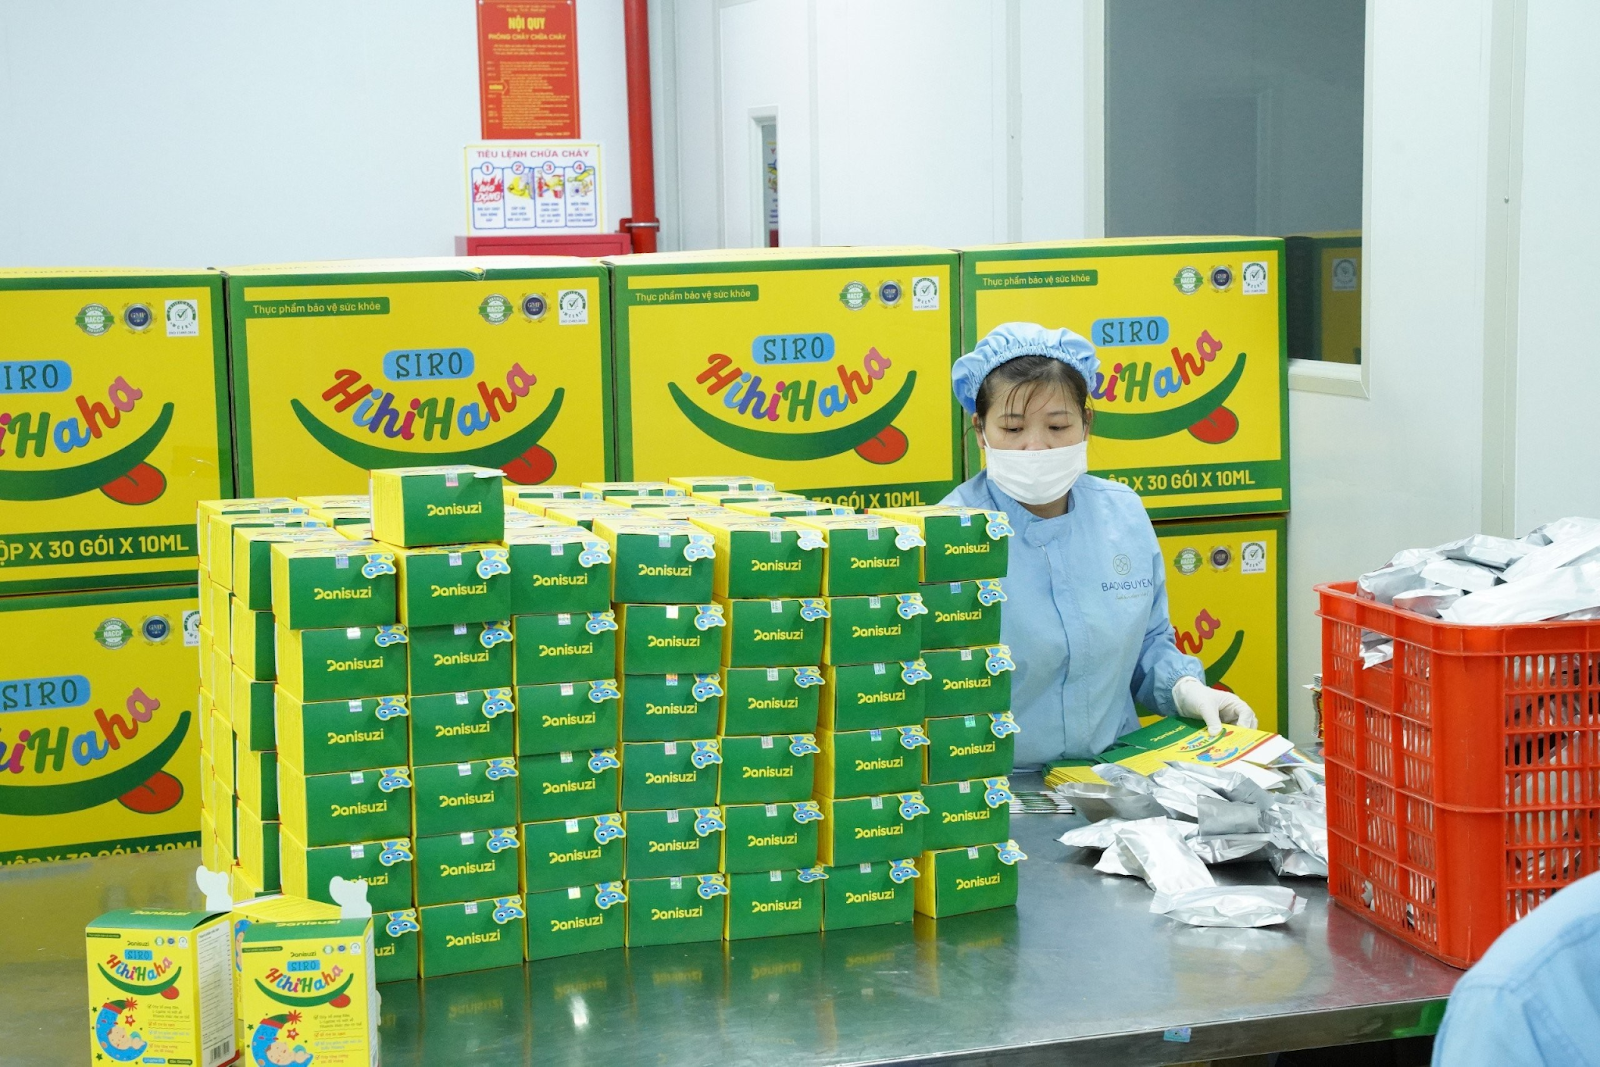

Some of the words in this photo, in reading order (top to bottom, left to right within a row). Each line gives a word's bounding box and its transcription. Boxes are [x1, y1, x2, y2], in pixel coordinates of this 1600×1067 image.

[508, 15, 525, 32] NỘI
[527, 17, 546, 31] QUY
[476, 149, 498, 158] TIÊU
[501, 149, 527, 160] LỆNH
[530, 149, 558, 158] CHỮA
[562, 149, 589, 158] CHÁY
[982, 277, 1003, 287] Thực
[1004, 275, 1027, 286] phẩm
[1028, 275, 1043, 284] bảo
[1044, 275, 1053, 285] vệ
[1055, 274, 1070, 283] sức
[1071, 273, 1090, 282] khỏe
[636, 293, 657, 303] Thực
[658, 290, 683, 302] phẩm
[684, 291, 700, 300] bảo
[702, 291, 712, 300] vệ
[713, 290, 729, 299] sức
[730, 289, 751, 298] khỏe
[253, 305, 277, 315] Thực
[279, 302, 305, 315] phẩm
[307, 303, 325, 313] bảo
[327, 303, 338, 313] vệ
[339, 302, 356, 312] sức
[358, 301, 381, 310] khỏe
[85, 315, 105, 324] HACCP
[1102, 319, 1159, 345] SIRO
[763, 336, 825, 363] SIRO
[395, 351, 463, 379] SIRO
[1091, 329, 1223, 402] iHaha
[4, 365, 59, 390] IRO
[695, 346, 892, 423] HihiHaha
[322, 362, 537, 441] HihiHaha
[0, 375, 143, 458] iHaha
[1133, 475, 1144, 491] X
[1147, 474, 1168, 490] 30
[1171, 469, 1198, 489] GÓI
[1201, 472, 1213, 487] X
[1216, 469, 1256, 486] 10ML
[869, 493, 881, 509] X
[884, 490, 926, 507] 10ML
[426, 503, 482, 517] Danisuzi
[0, 539, 24, 566] ỘP
[29, 542, 43, 559] X
[48, 540, 74, 558] 30
[79, 534, 114, 557] GÓI
[119, 536, 134, 554] X
[138, 534, 190, 553] 10ML
[944, 542, 990, 556] Danisuzi
[638, 564, 692, 577] Danisuzi
[751, 559, 802, 572] Danisuzi
[850, 557, 900, 569] Danisuzi
[532, 574, 588, 587] Danisuzi
[313, 586, 372, 601] Danisuzi
[430, 582, 487, 598] Danisuzi
[934, 609, 982, 623] Danisuzi
[753, 629, 804, 641] Danisuzi
[851, 624, 902, 638] Danisuzi
[647, 635, 701, 648] Danisuzi
[538, 643, 593, 657] Danisuzi
[326, 656, 384, 672] Danisuzi
[433, 649, 490, 667] Danisuzi
[942, 678, 992, 691] Danisuzi
[2, 679, 77, 710] SIRO
[857, 689, 906, 705] Danisuzi
[646, 703, 698, 715] Danisuzi
[747, 697, 799, 710] Danisuzi
[541, 712, 596, 728] Danisuzi
[0, 687, 160, 774] iHaha
[327, 729, 384, 745] Danisuzi
[434, 721, 491, 738] Danisuzi
[949, 742, 996, 757] Danisuzi
[742, 766, 794, 778] Danisuzi
[855, 757, 904, 772] Danisuzi
[645, 771, 697, 785] Danisuzi
[542, 778, 596, 795] Danisuzi
[439, 791, 495, 808] Danisuzi
[330, 802, 388, 817] Danisuzi
[941, 809, 990, 824] Danisuzi
[854, 824, 904, 839] Danisuzi
[649, 839, 700, 853] Danisuzi
[747, 834, 798, 847] Danisuzi
[548, 846, 602, 864] Danisuzi
[439, 860, 496, 877] Danisuzi
[955, 873, 1001, 891] Danisuzi
[845, 889, 895, 904] Danisuzi
[651, 906, 703, 921] Danisuzi
[751, 899, 802, 913] Danisuzi
[550, 913, 604, 932] Danisuzi
[445, 929, 501, 948] Danisuzi
[127, 950, 150, 960] SIRO
[106, 954, 173, 981] HihiHaha
[291, 961, 317, 971] SIRO
[265, 965, 343, 993] HihiHaha
